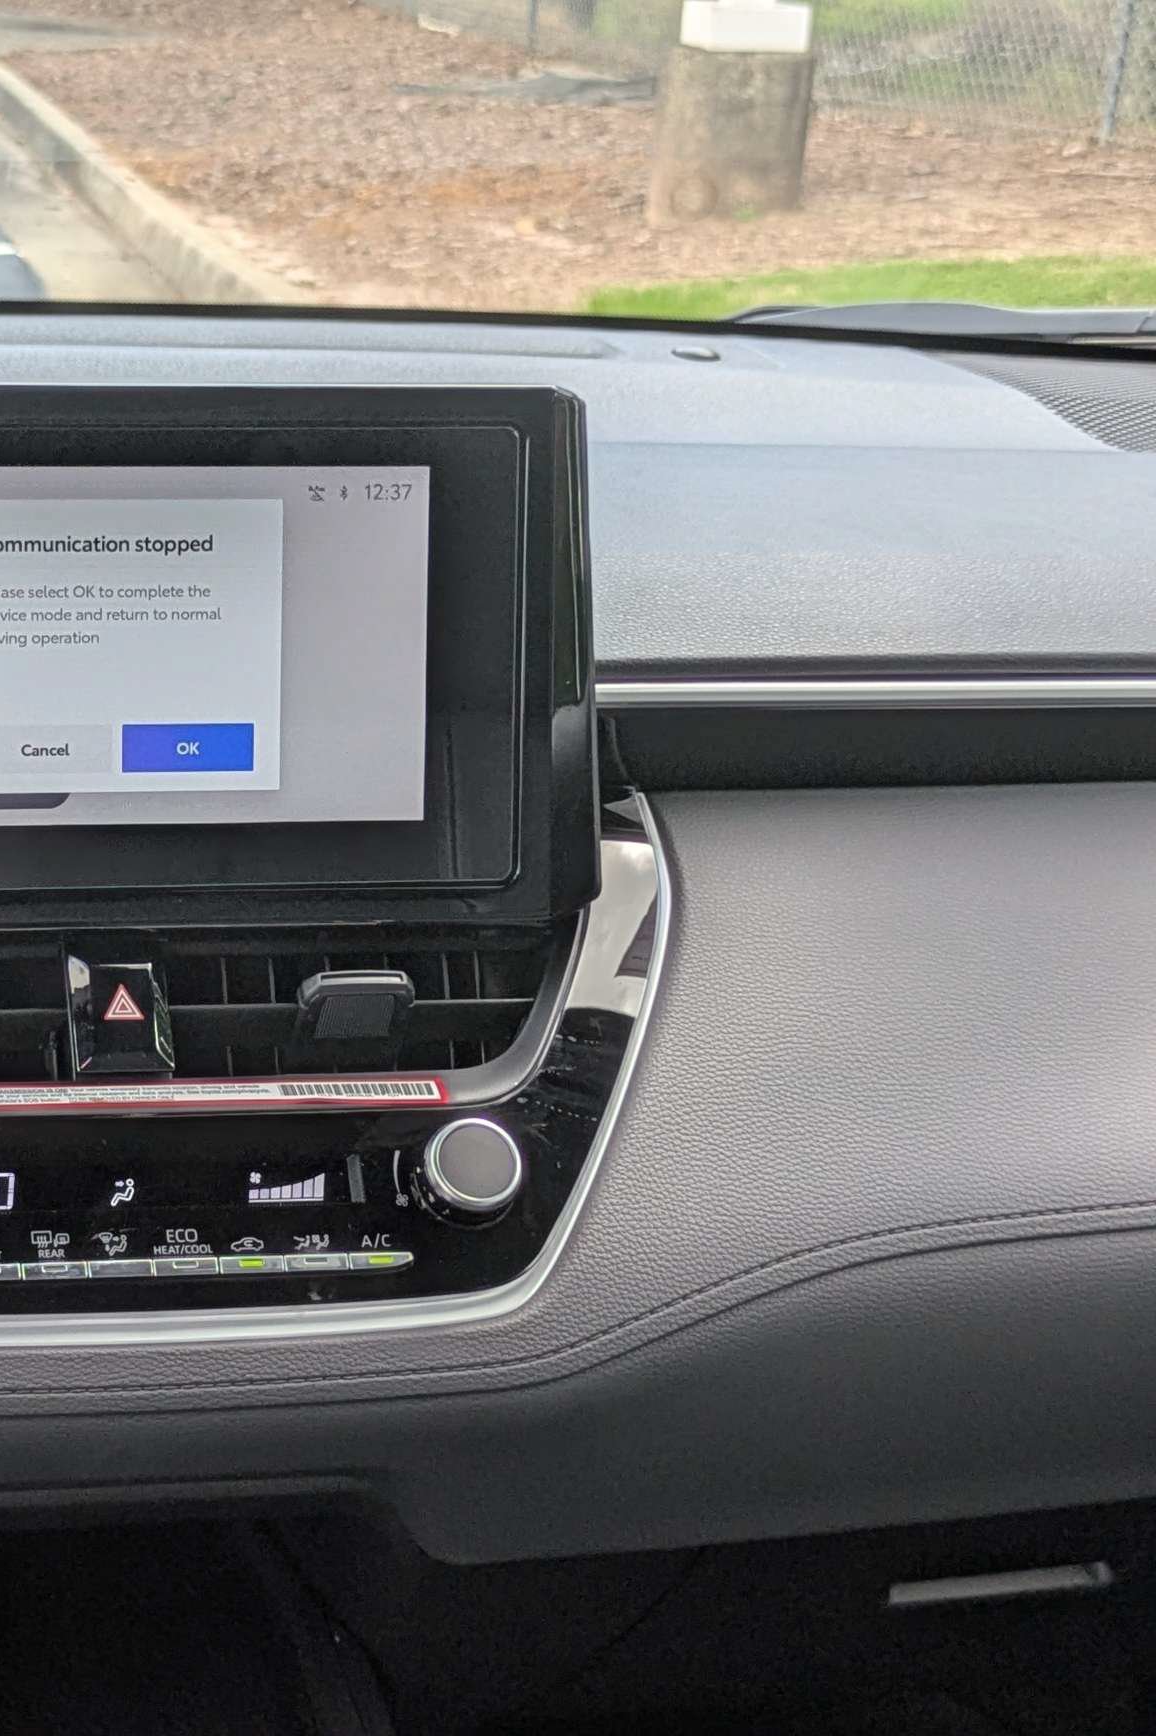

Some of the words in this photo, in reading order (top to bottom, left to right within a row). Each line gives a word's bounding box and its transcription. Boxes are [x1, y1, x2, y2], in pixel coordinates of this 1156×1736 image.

[365, 483, 412, 501] 12:37
[135, 535, 214, 556] stopped
[28, 585, 69, 599] select
[73, 585, 94, 598] OK
[99, 586, 114, 598] to
[117, 585, 184, 600] complete
[188, 584, 211, 597] the
[31, 608, 72, 621] mode
[76, 608, 103, 621] and
[106, 608, 149, 621] return
[153, 607, 167, 620] to
[171, 607, 221, 620] normal
[31, 631, 99, 647] operation
[20, 743, 70, 757] Cancel
[176, 741, 200, 756] OK
[165, 1229, 198, 1243] ECO
[361, 1233, 391, 1247] A/C
[38, 1248, 66, 1259] REAR
[153, 1243, 214, 1255] HEAT/COOL
